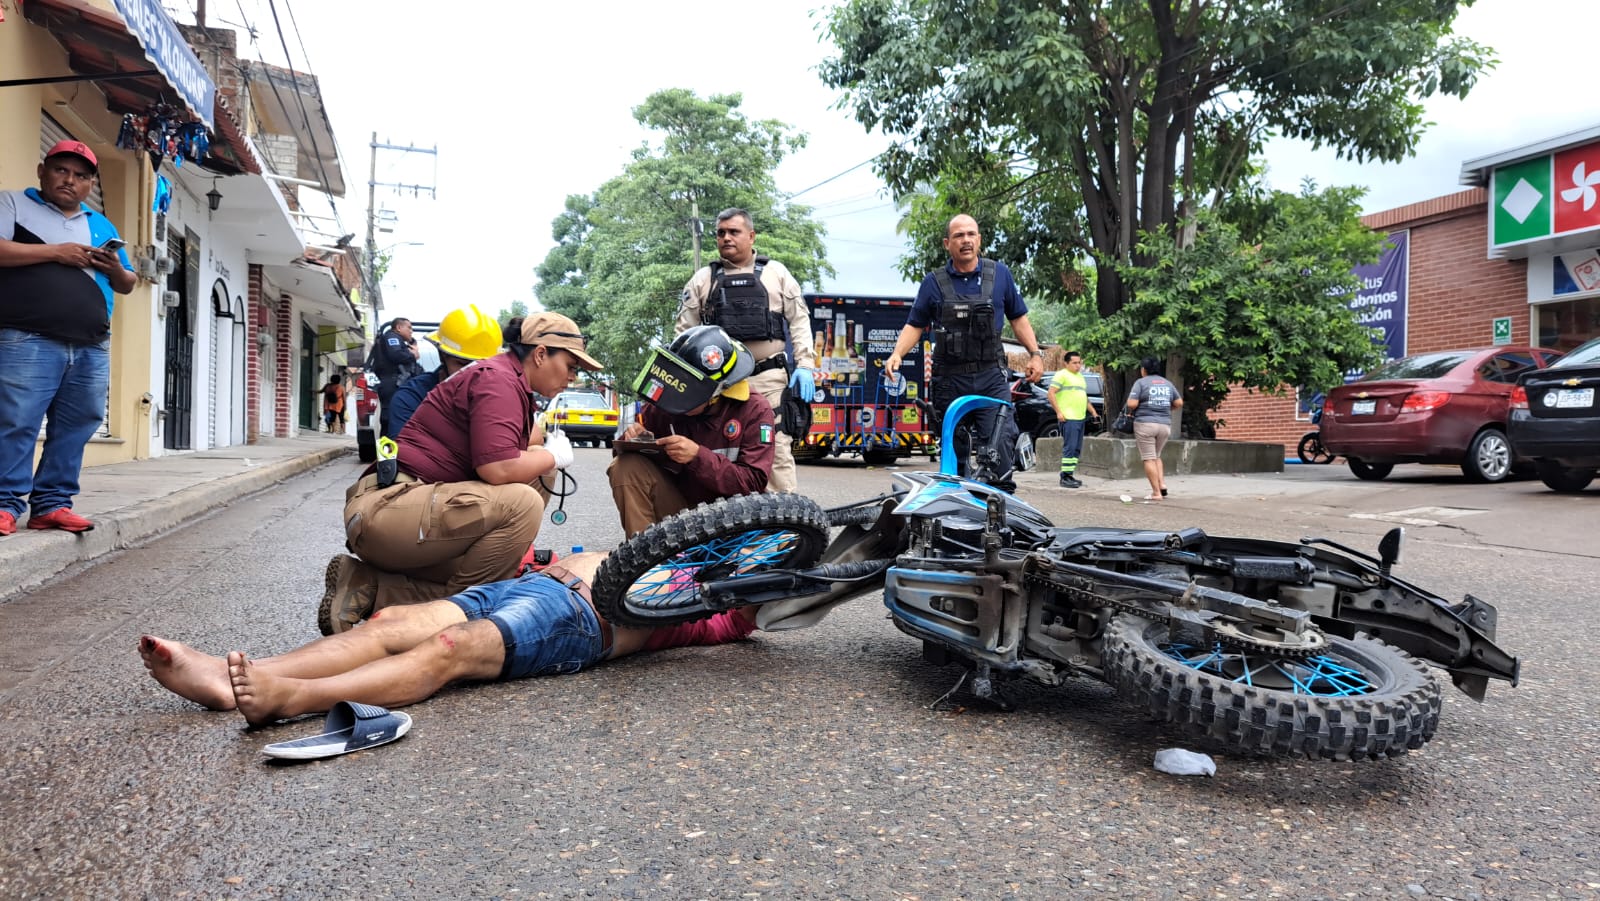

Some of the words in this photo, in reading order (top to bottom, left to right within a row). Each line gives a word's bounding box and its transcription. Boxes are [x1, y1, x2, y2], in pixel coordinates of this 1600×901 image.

[1364, 277, 1383, 290] tus
[1350, 291, 1398, 309] abonos
[650, 363, 687, 393] VARGAS
[1149, 386, 1170, 396] ONE
